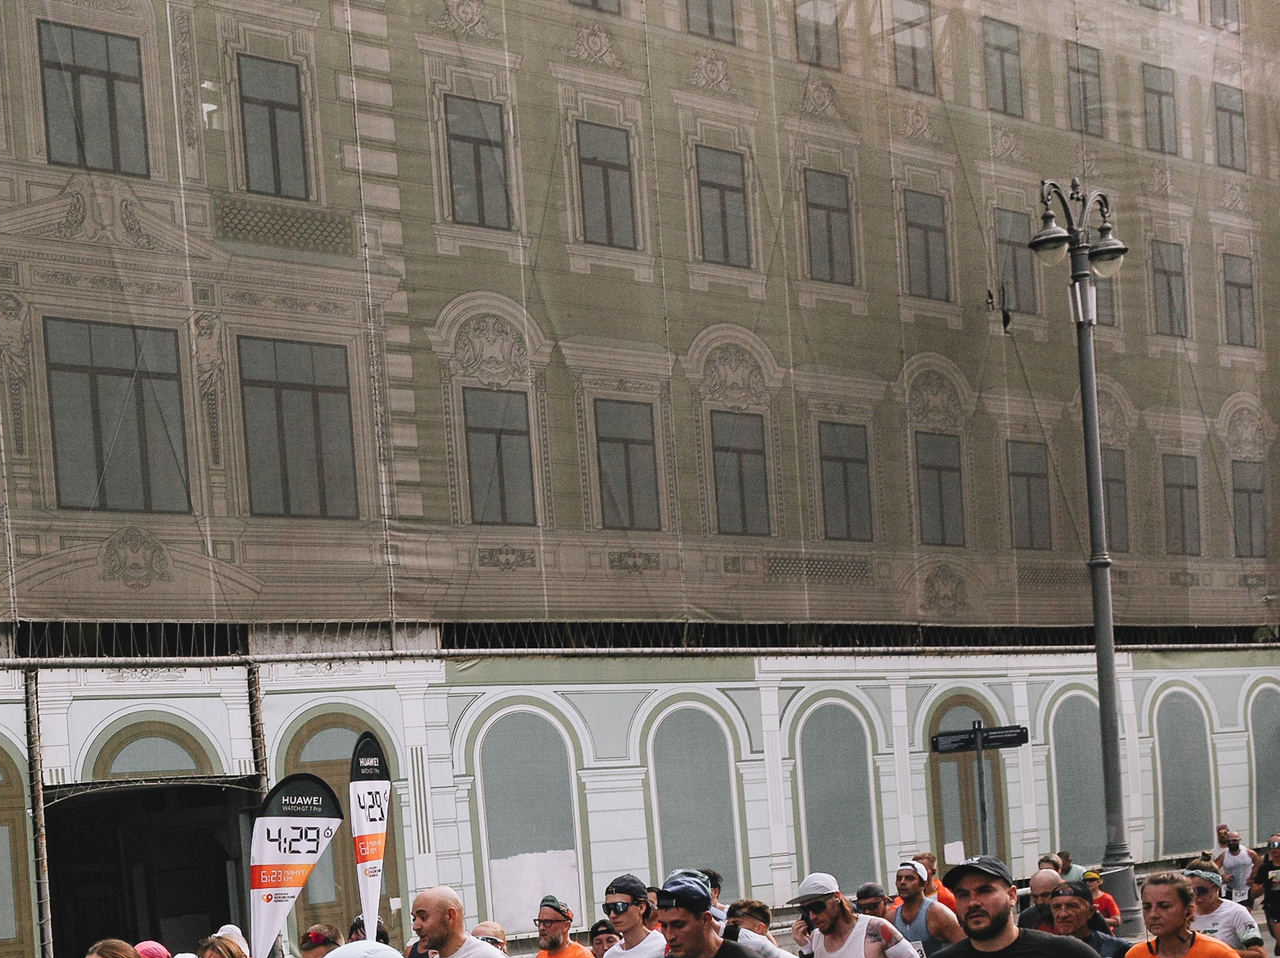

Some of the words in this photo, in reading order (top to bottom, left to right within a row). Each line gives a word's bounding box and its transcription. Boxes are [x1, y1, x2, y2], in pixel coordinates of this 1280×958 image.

[359, 757, 380, 767] HUAWEI
[282, 796, 322, 806] HUAWEI
[267, 826, 320, 854] 4:29
[261, 870, 283, 883] 6:23
